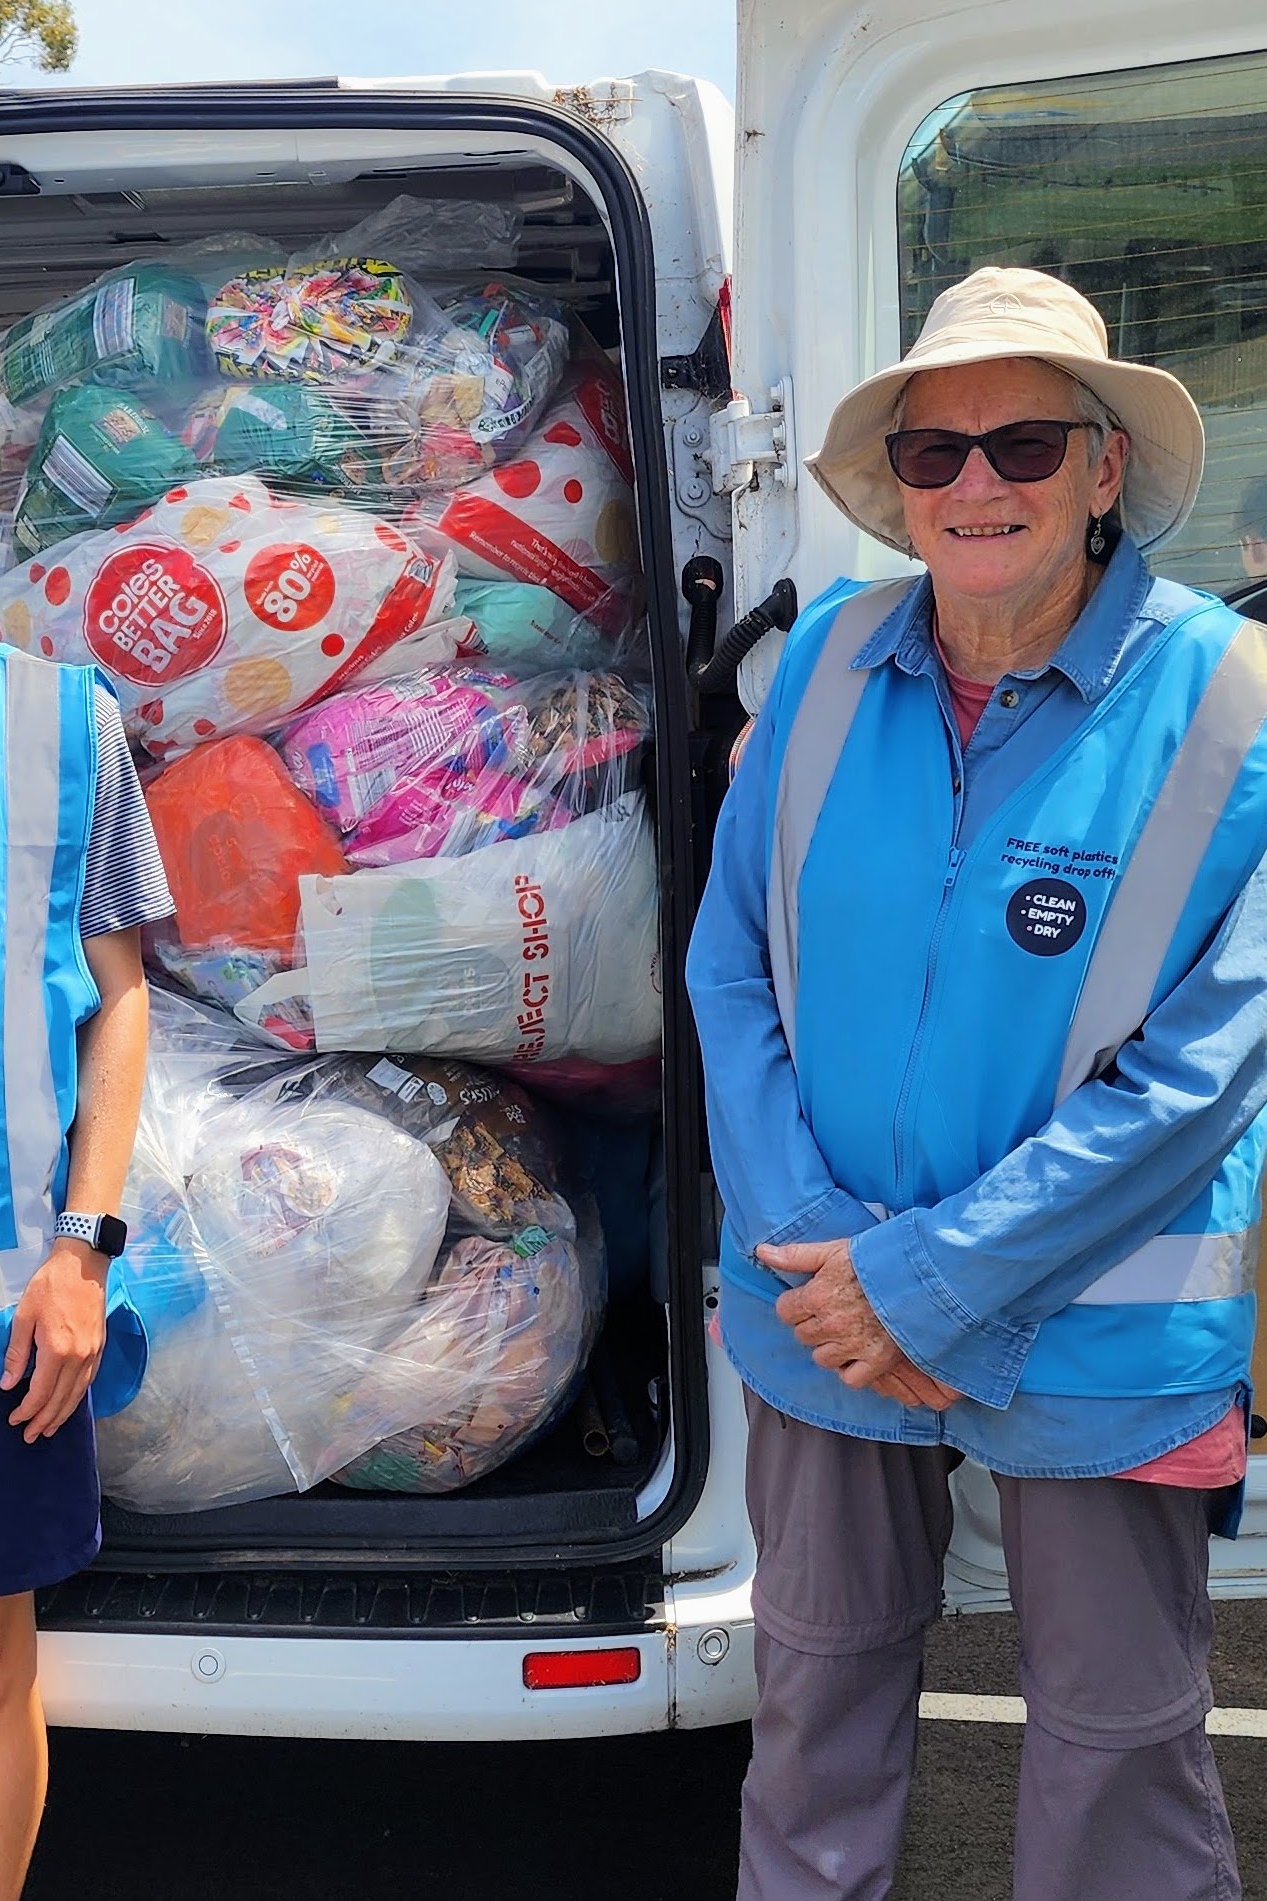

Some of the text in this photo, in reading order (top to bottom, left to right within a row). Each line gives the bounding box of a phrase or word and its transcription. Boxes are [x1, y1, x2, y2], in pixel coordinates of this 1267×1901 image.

[99, 558, 164, 634] Coles
[112, 574, 181, 652] BETTER
[131, 591, 209, 674] BAG
[1006, 837, 1119, 865] FREE soft plastics
[1000, 853, 1061, 875] recycling
[1062, 863, 1092, 880] drop
[1027, 907, 1075, 926] EMPTY
[1033, 894, 1077, 912] CLEAN
[514, 874, 550, 961] SHOP
[1033, 923, 1062, 939] DRY
